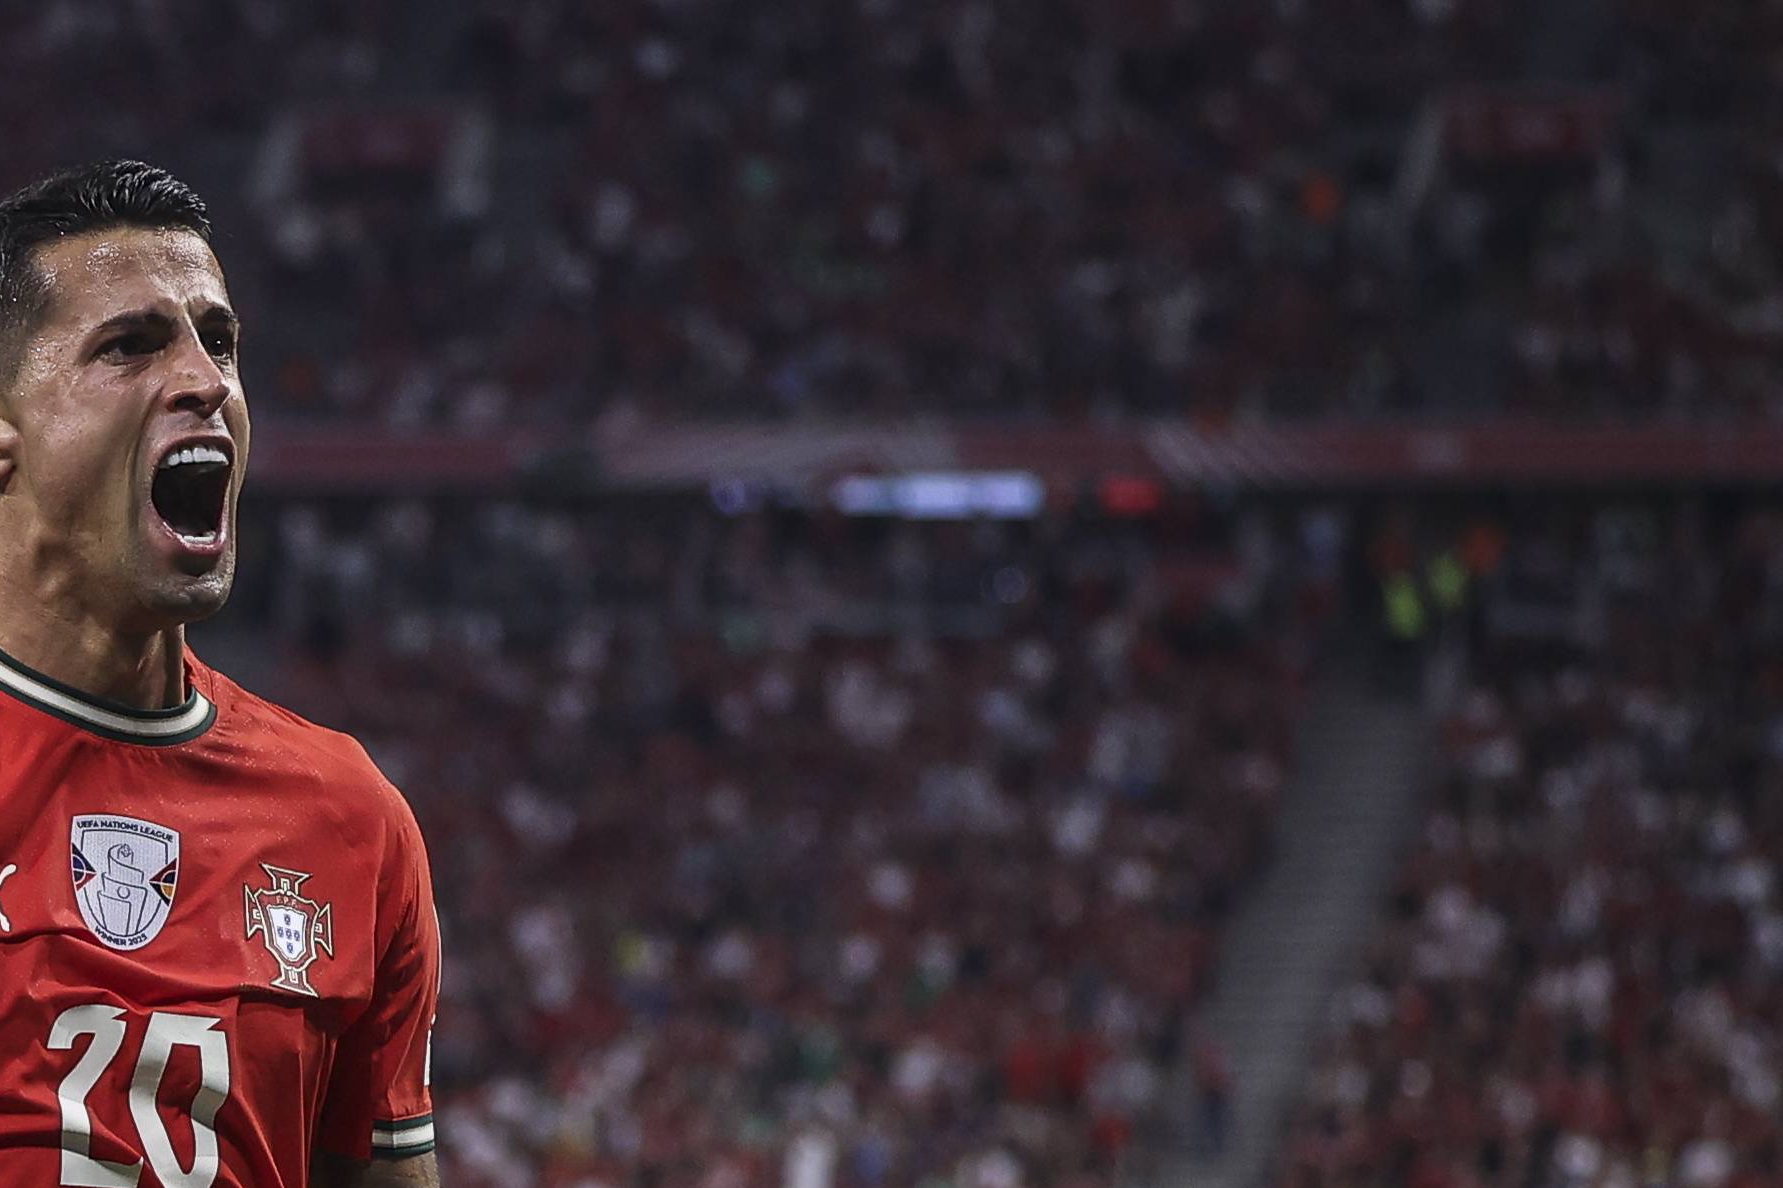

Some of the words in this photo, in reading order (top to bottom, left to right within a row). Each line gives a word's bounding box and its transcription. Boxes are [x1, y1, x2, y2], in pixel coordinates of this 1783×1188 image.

[77, 820, 99, 829] UEFA
[101, 820, 138, 832] NATIONS
[140, 826, 173, 842] LEAGUE
[95, 926, 127, 946] WINNER
[128, 933, 148, 946] 2025
